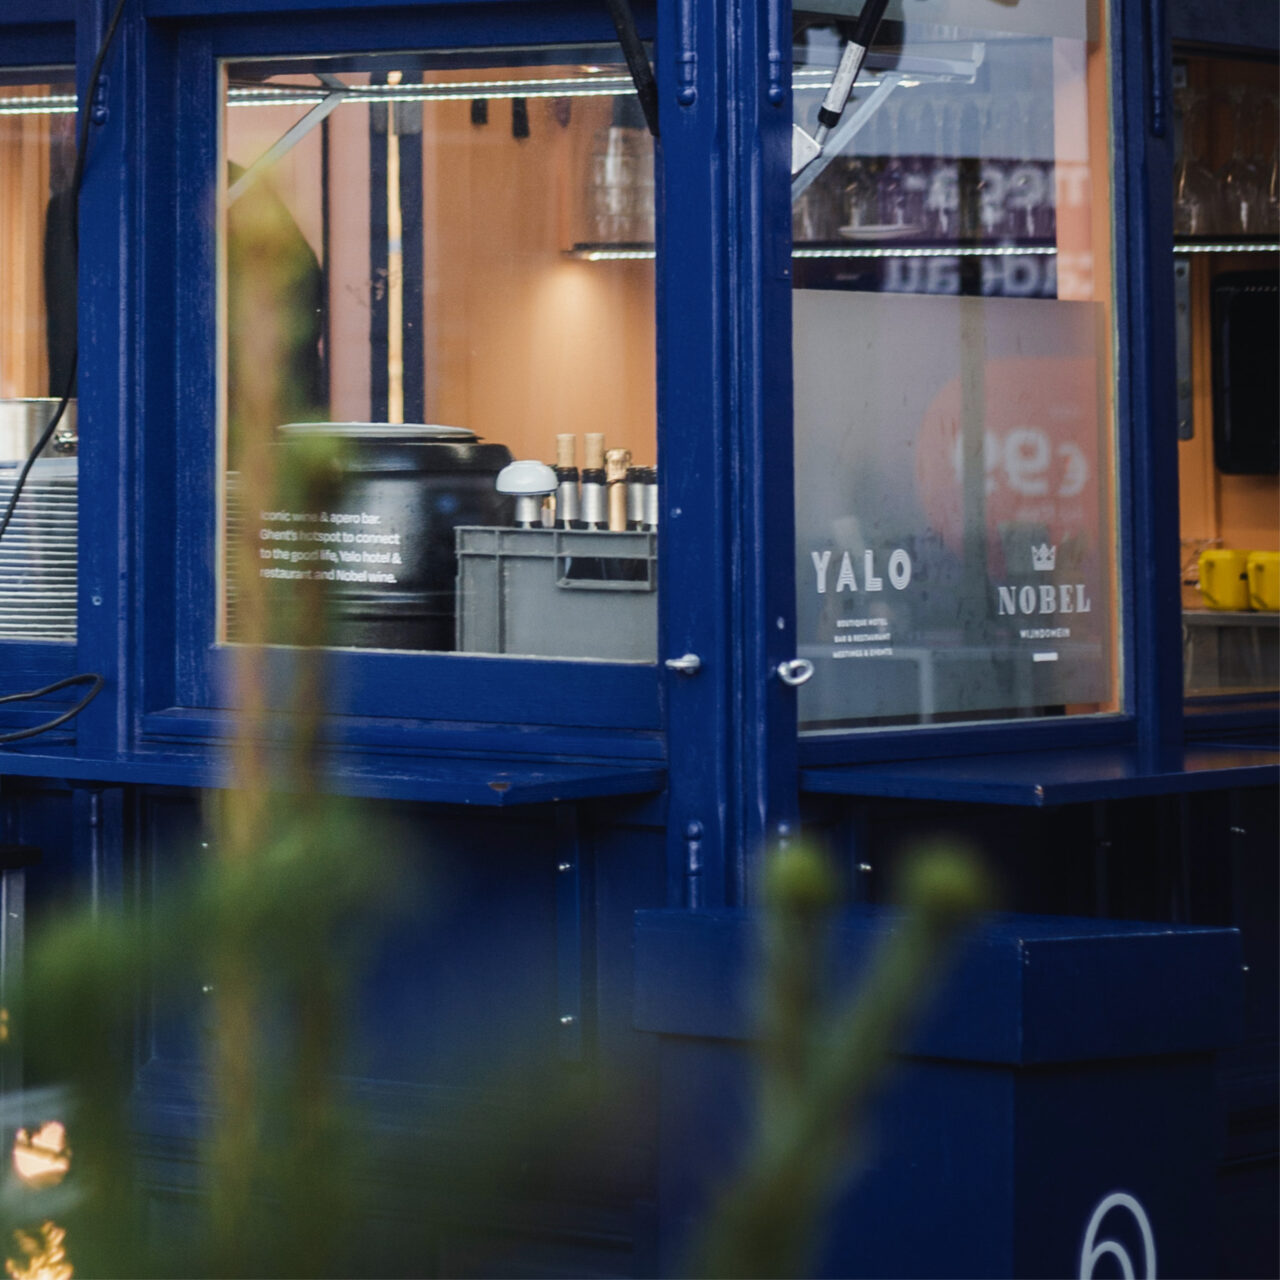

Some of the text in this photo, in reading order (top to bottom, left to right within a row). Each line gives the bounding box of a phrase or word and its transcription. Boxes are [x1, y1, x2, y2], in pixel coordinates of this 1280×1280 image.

[330, 513, 360, 525] apero
[342, 532, 354, 543] to
[355, 533, 400, 544] connect
[260, 548, 272, 559] to
[272, 548, 290, 559] the
[338, 550, 361, 562] Yalo
[362, 551, 391, 563] hotel
[260, 568, 313, 580] restaurant
[314, 569, 335, 580] and
[336, 569, 367, 581] Nobel
[811, 548, 912, 593] YALO
[998, 584, 1091, 615] NOBEL
[868, 618, 888, 626] HOTEL
[834, 635, 846, 643] BAR
[853, 633, 891, 642] RESTAURANT
[1020, 628, 1070, 639] WIJNDOMEIN
